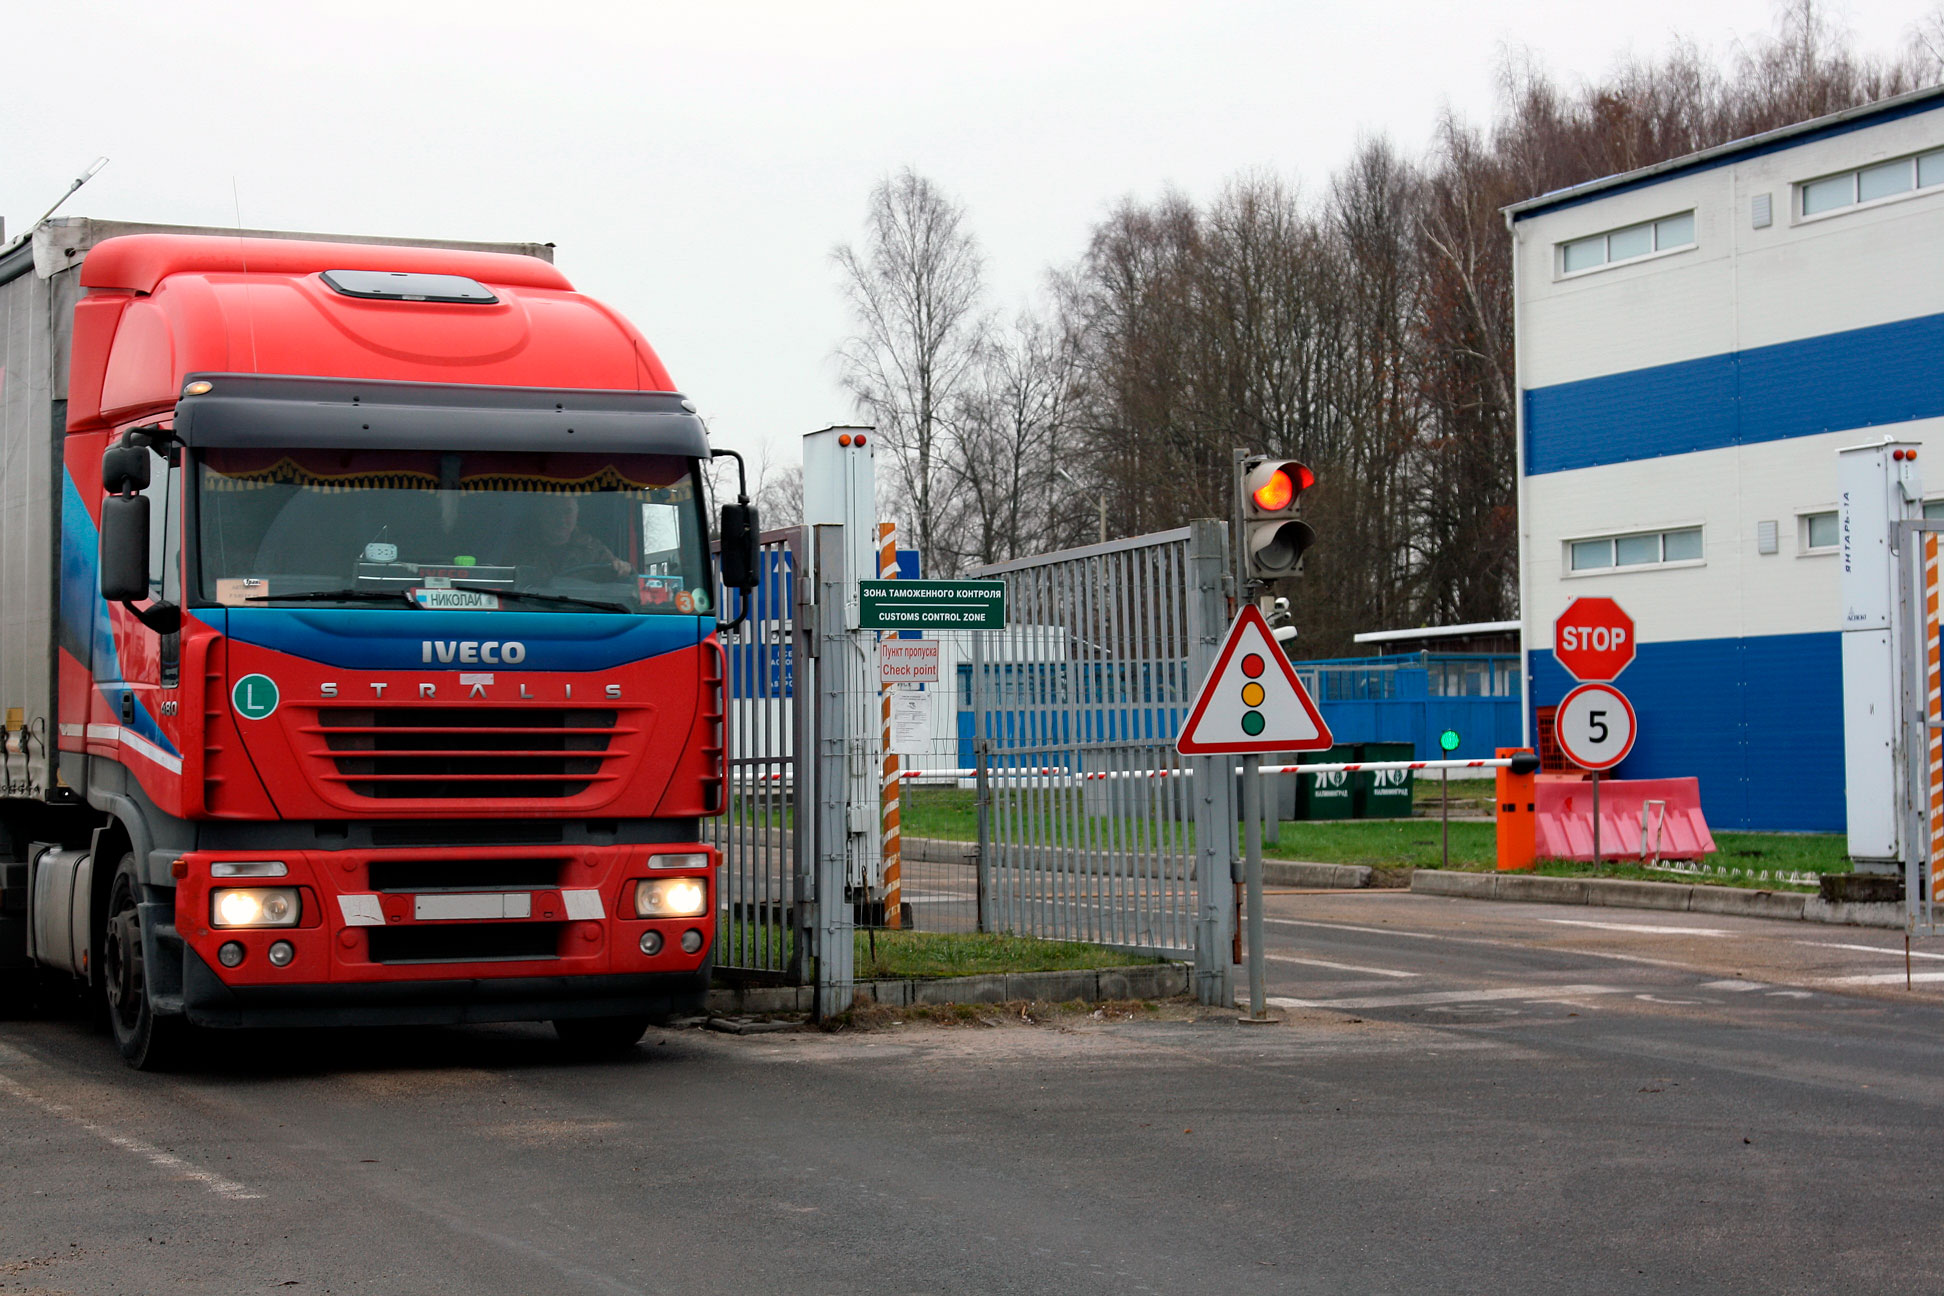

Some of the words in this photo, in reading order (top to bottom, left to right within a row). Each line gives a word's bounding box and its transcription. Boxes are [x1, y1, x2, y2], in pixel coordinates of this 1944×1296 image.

[1843, 492, 1851, 573] ЯНТАРЬ-1А
[419, 568, 469, 578] IVECO
[863, 588, 887, 598] ЗОНА
[889, 589, 954, 598] ТАМОЖЕННОГО
[956, 589, 1002, 599] КОНТРОЛЯ
[878, 612, 920, 621] CUSTOMS
[921, 612, 961, 622] CONTROL
[962, 613, 986, 622] ZONE
[1562, 626, 1626, 651] STOP
[422, 641, 526, 664] IVECO
[882, 645, 903, 660] Пункт
[904, 647, 937, 660] пропуска
[882, 664, 911, 675] Check
[913, 665, 937, 677] point
[247, 683, 265, 710] L
[320, 682, 622, 699] STRALIS
[161, 701, 178, 716] 480
[1588, 710, 1609, 743] 5
